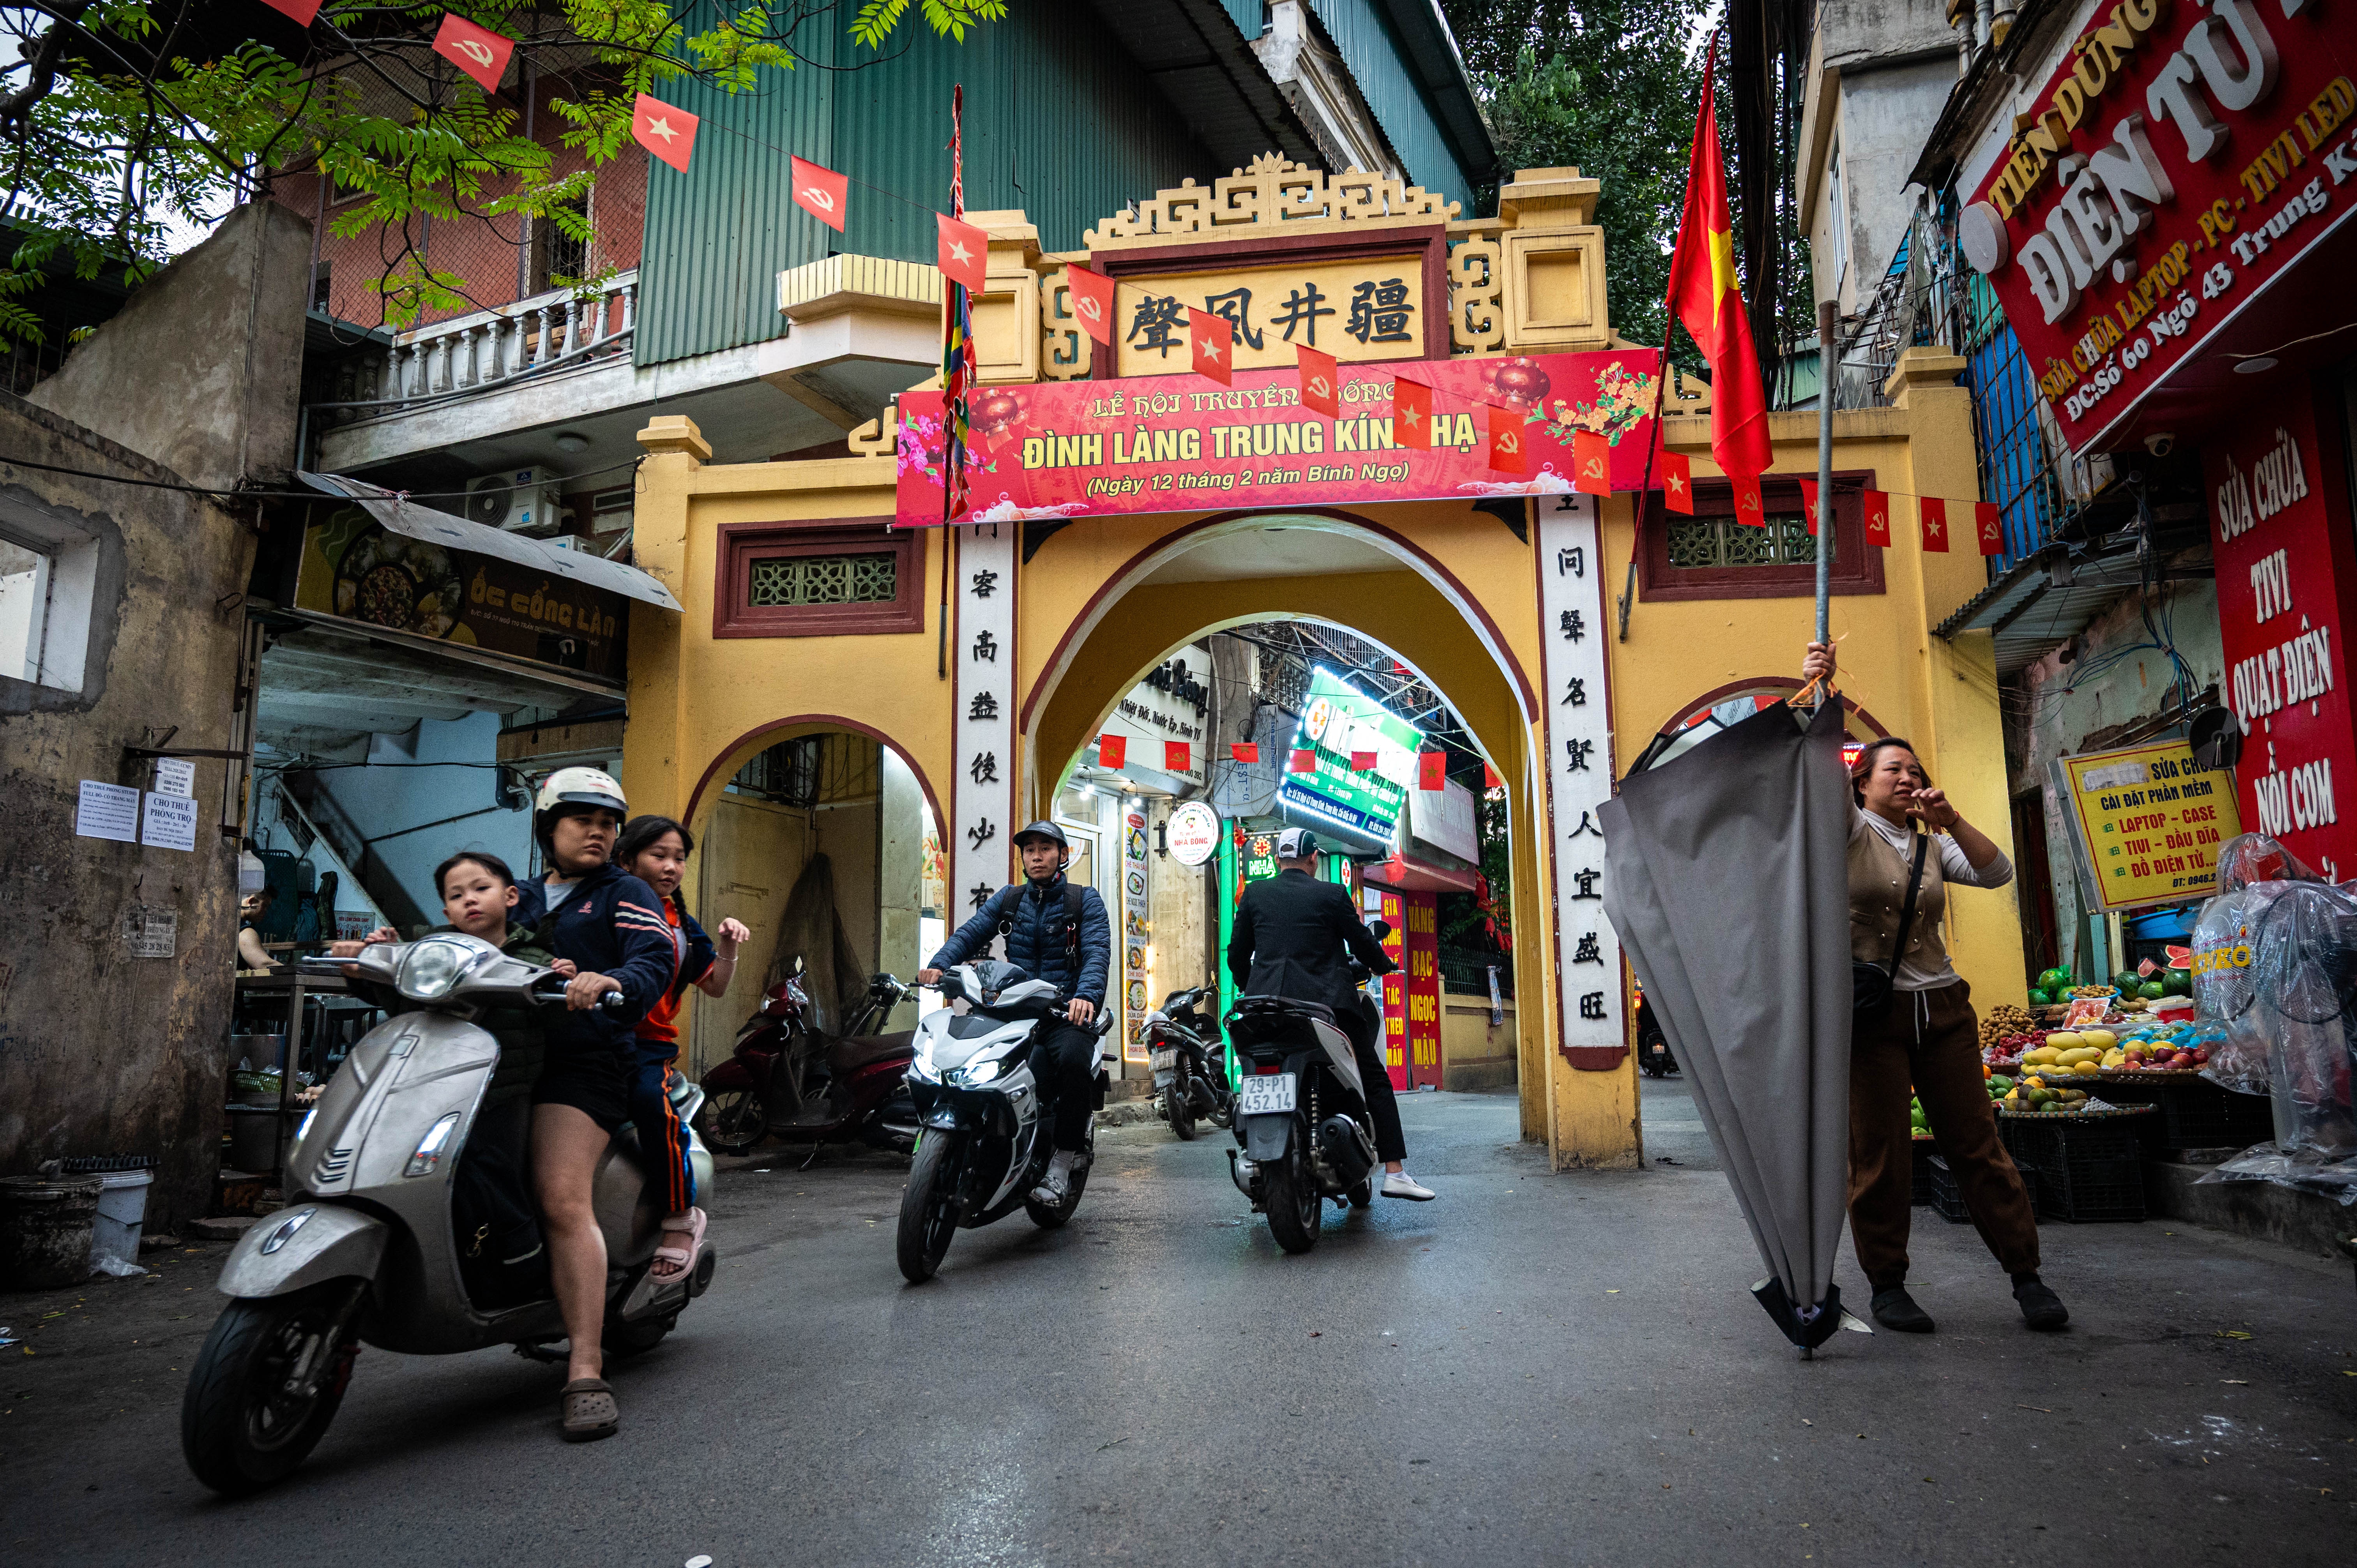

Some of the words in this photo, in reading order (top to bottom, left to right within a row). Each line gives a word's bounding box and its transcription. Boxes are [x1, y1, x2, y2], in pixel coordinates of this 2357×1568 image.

[1988, 108, 2070, 221] TIẾN
[2016, 112, 2174, 325] ĐIỆN
[2115, 239, 2191, 332] LAPTOP
[2198, 197, 2237, 248] PC
[2240, 129, 2306, 203] TIVI
[2295, 76, 2357, 151] LED
[2122, 337, 2150, 369] 60
[2147, 289, 2198, 346] Ngõ
[2202, 261, 2234, 299] 43
[2231, 175, 2330, 267] Trung
[1092, 390, 1126, 418] LỄ
[1189, 382, 1299, 412] TRUYỀN
[1023, 431, 1103, 469] ĐÌNH
[1113, 425, 1201, 464] LÀNG
[1210, 421, 1323, 459] TRUNG
[1334, 412, 1404, 453] KÍN
[1431, 413, 1478, 453] HẠ
[1087, 477, 1144, 498] (Ngày
[1151, 474, 1172, 491] 12
[1178, 472, 1234, 492] tháng
[1240, 470, 1253, 486] 2
[1258, 467, 1300, 485] năm
[1307, 463, 1354, 482] Bính
[1361, 462, 1410, 484] Ngọ)
[2251, 549, 2293, 624] TIVI
[2234, 646, 2283, 736] QUẠT
[2282, 614, 2334, 717] ĐIỆN
[1152, 711, 1168, 727] Nước
[1180, 722, 1193, 738] Sinh
[1194, 727, 1202, 741] Tố
[2151, 757, 2179, 780] SỬA
[154, 798, 170, 808] CHO
[171, 802, 190, 811] THUÊ
[2101, 793, 2121, 810] CÀI
[2123, 790, 2145, 809] ĐẶT
[2148, 782, 2180, 803] PHẦN
[2181, 778, 2214, 799] MỀM
[2254, 741, 2292, 837] NỒI
[150, 808, 175, 819] PHÒNG
[177, 813, 191, 824] TRỌ
[2118, 813, 2166, 834] LAPTOP
[2182, 805, 2217, 824] CASE
[2124, 839, 2151, 856] TIVI
[2166, 828, 2194, 849] ĐẦU
[2196, 826, 2221, 845] ĐĨA
[2131, 856, 2150, 878] ĐỒ
[2154, 855, 2186, 876] ĐIỆN
[2173, 876, 2186, 888] ĐT:
[1384, 899, 1398, 916] GIA
[1408, 901, 1434, 934] VÀNG
[1413, 950, 1433, 981] BẠC
[1386, 984, 1400, 1005] TÁC
[1410, 994, 1436, 1026] NGỌC
[1385, 1017, 1404, 1035] THEO
[1413, 1033, 1436, 1069] MẬU
[1249, 1076, 1286, 1094] 29-P1
[1244, 1093, 1292, 1112] 452.14
